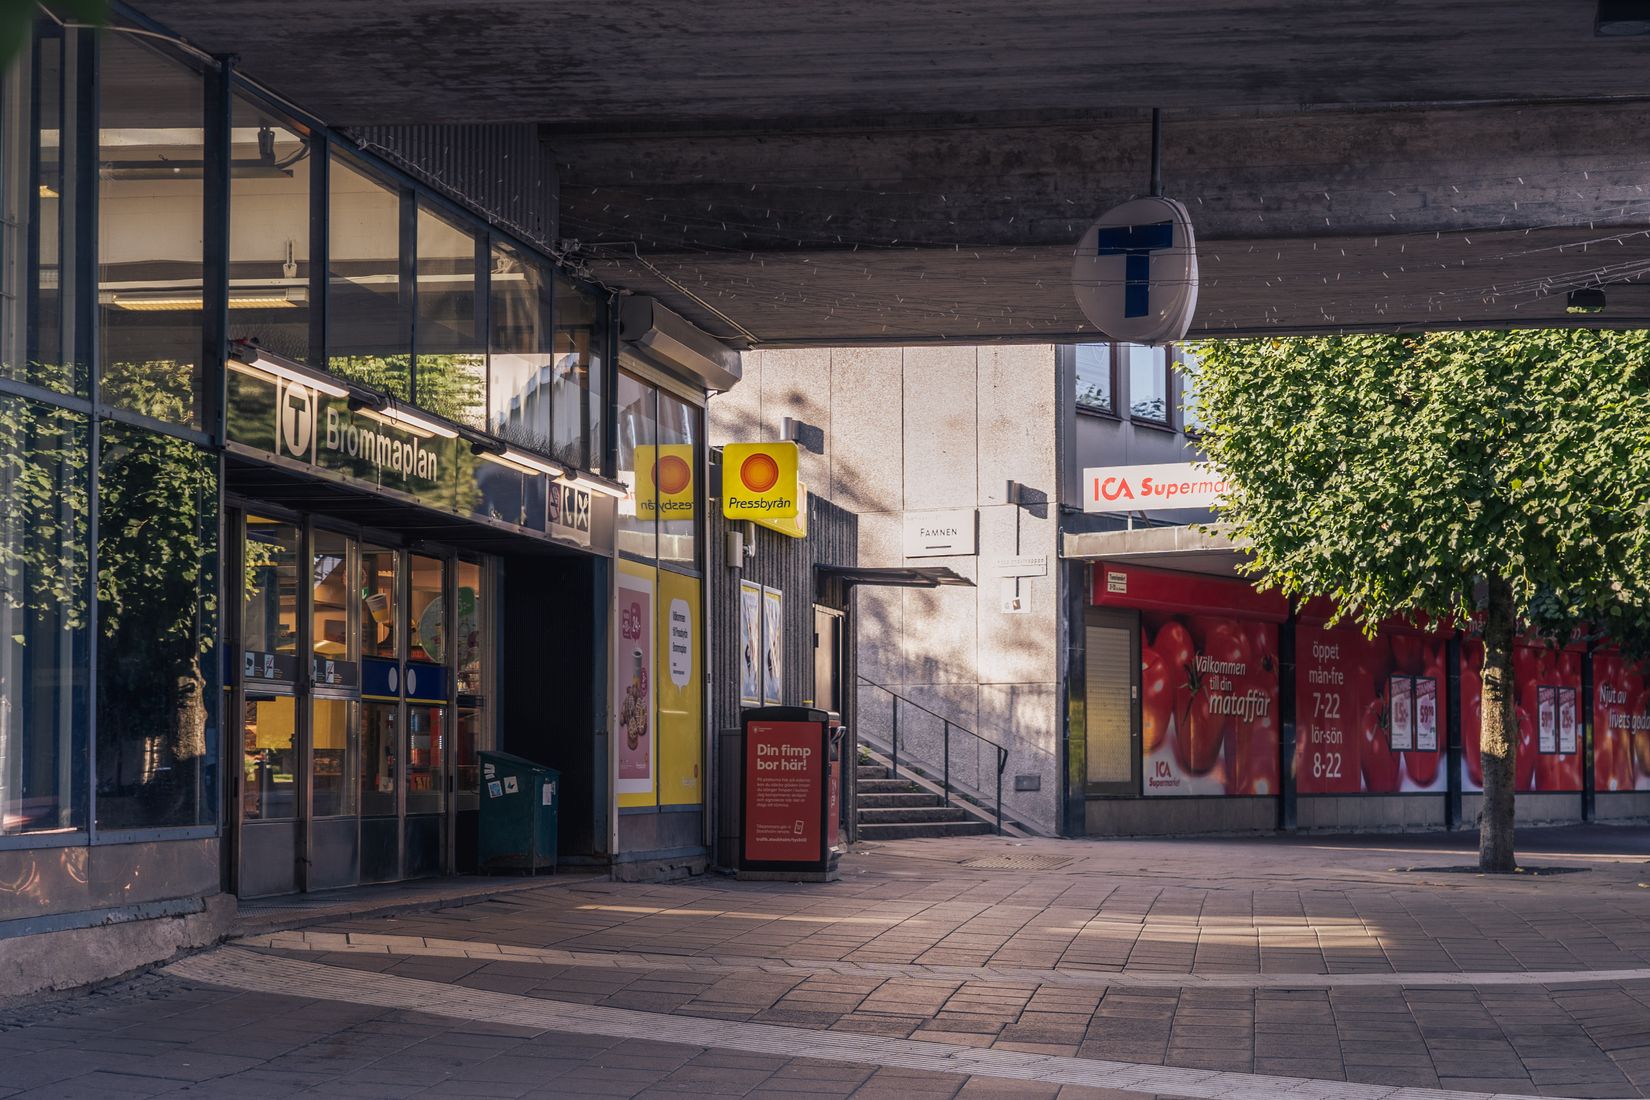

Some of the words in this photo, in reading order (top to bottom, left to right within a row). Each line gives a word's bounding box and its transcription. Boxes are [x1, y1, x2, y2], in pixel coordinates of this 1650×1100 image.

[1098, 220, 1173, 318] T
[326, 406, 438, 482] Brommaplan
[1094, 477, 1135, 502] ICA
[1140, 477, 1229, 499] Supermar
[729, 497, 791, 511] Pressbyrån
[1312, 641, 1340, 663] öppet
[1196, 656, 1246, 675] Välkommen
[1209, 676, 1219, 690] till
[1220, 678, 1232, 691] din
[1209, 689, 1270, 723] mataffär
[1599, 685, 1617, 708] Njut
[1617, 690, 1627, 704] av
[1609, 709, 1630, 728] livets
[757, 744, 779, 756] Din
[781, 744, 811, 759] fimp
[757, 758, 779, 770] bor
[781, 758, 807, 770] här!
[1155, 761, 1171, 778] ICA
